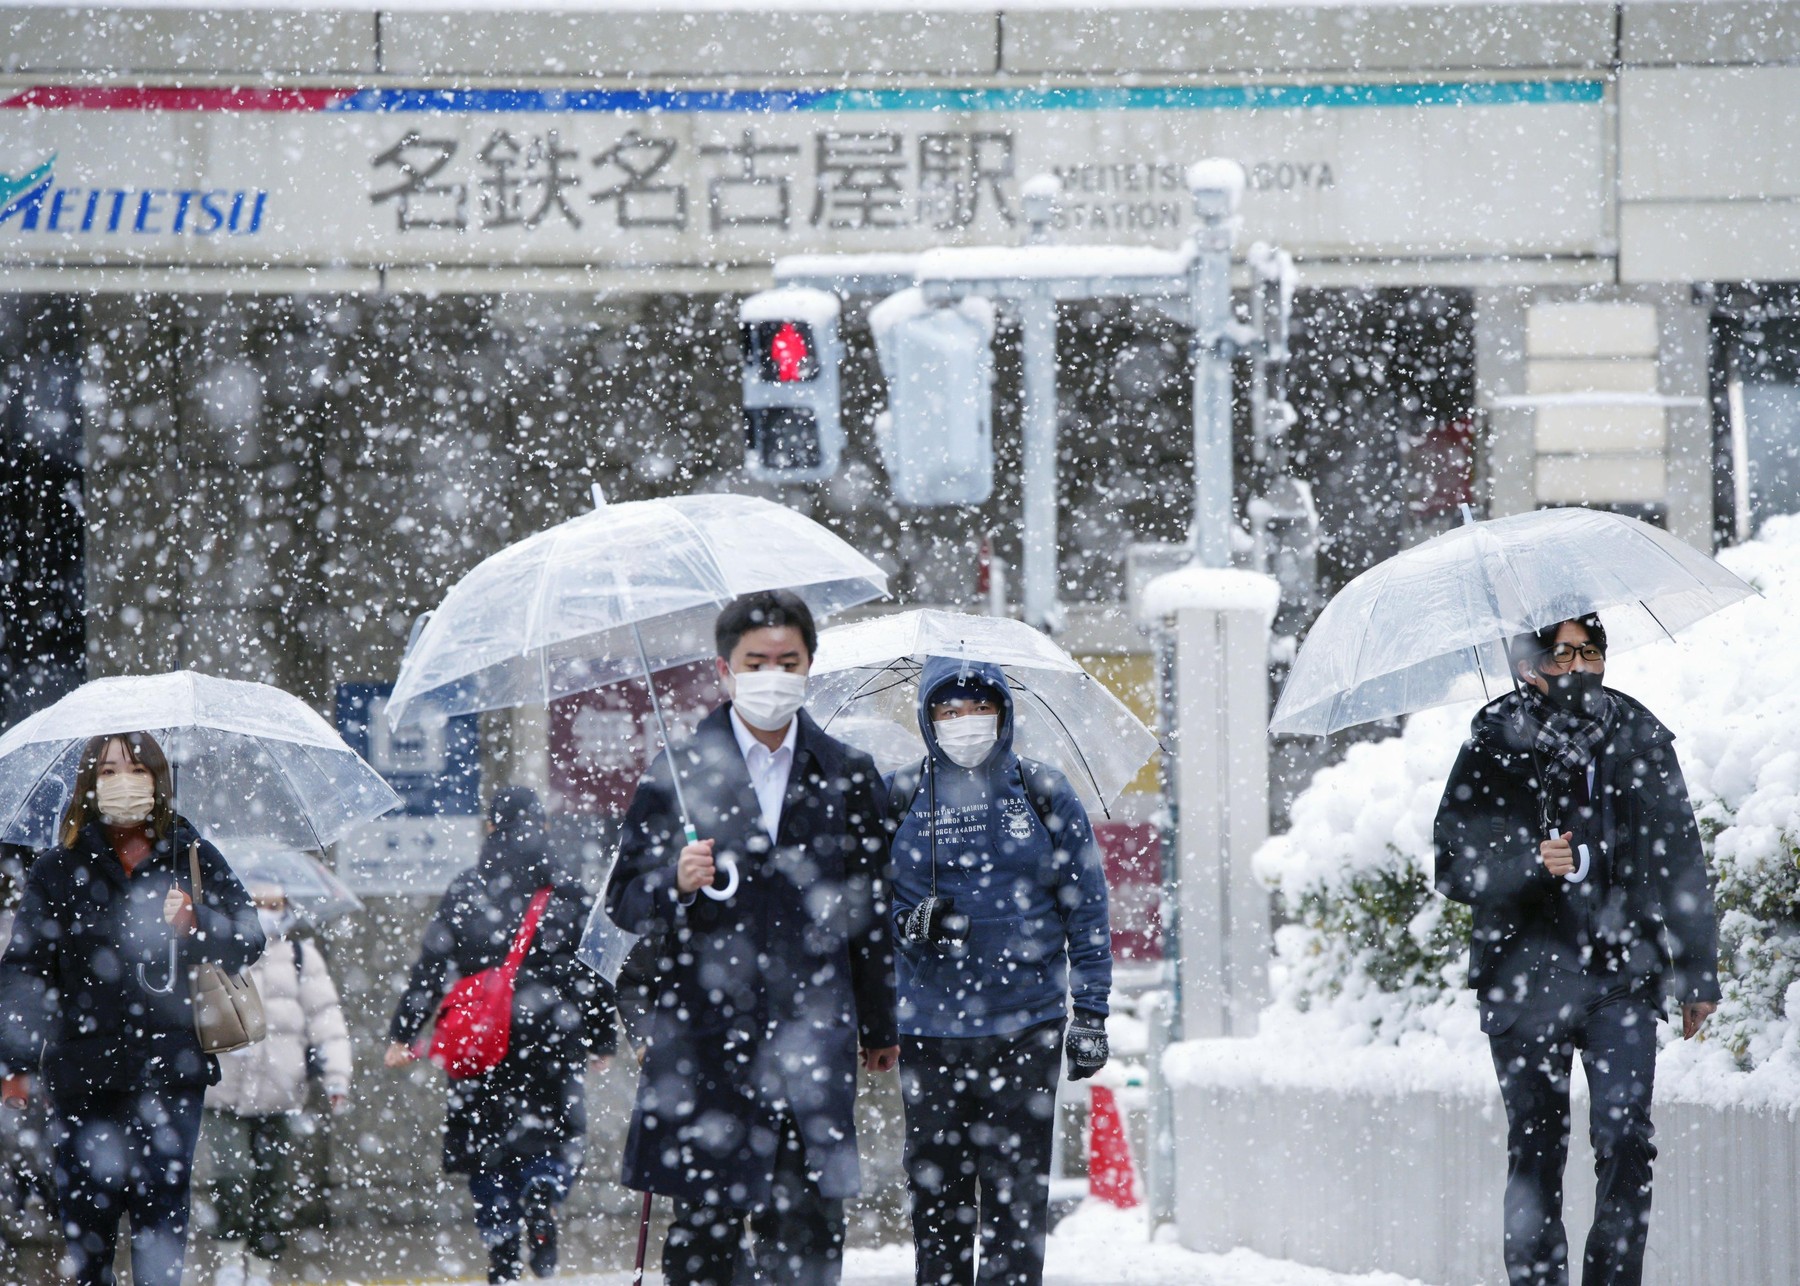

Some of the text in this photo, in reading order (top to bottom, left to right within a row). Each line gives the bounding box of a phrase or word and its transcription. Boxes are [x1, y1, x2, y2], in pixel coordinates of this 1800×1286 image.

[370, 129, 1016, 232] 名鉄名古屋駅
[1053, 162, 1335, 192] MEITETS GOYA
[1052, 203, 1181, 231] STATION
[957, 803, 989, 815] RAINING
[935, 827, 953, 836] ORCE
[954, 824, 987, 834] ACADEMY
